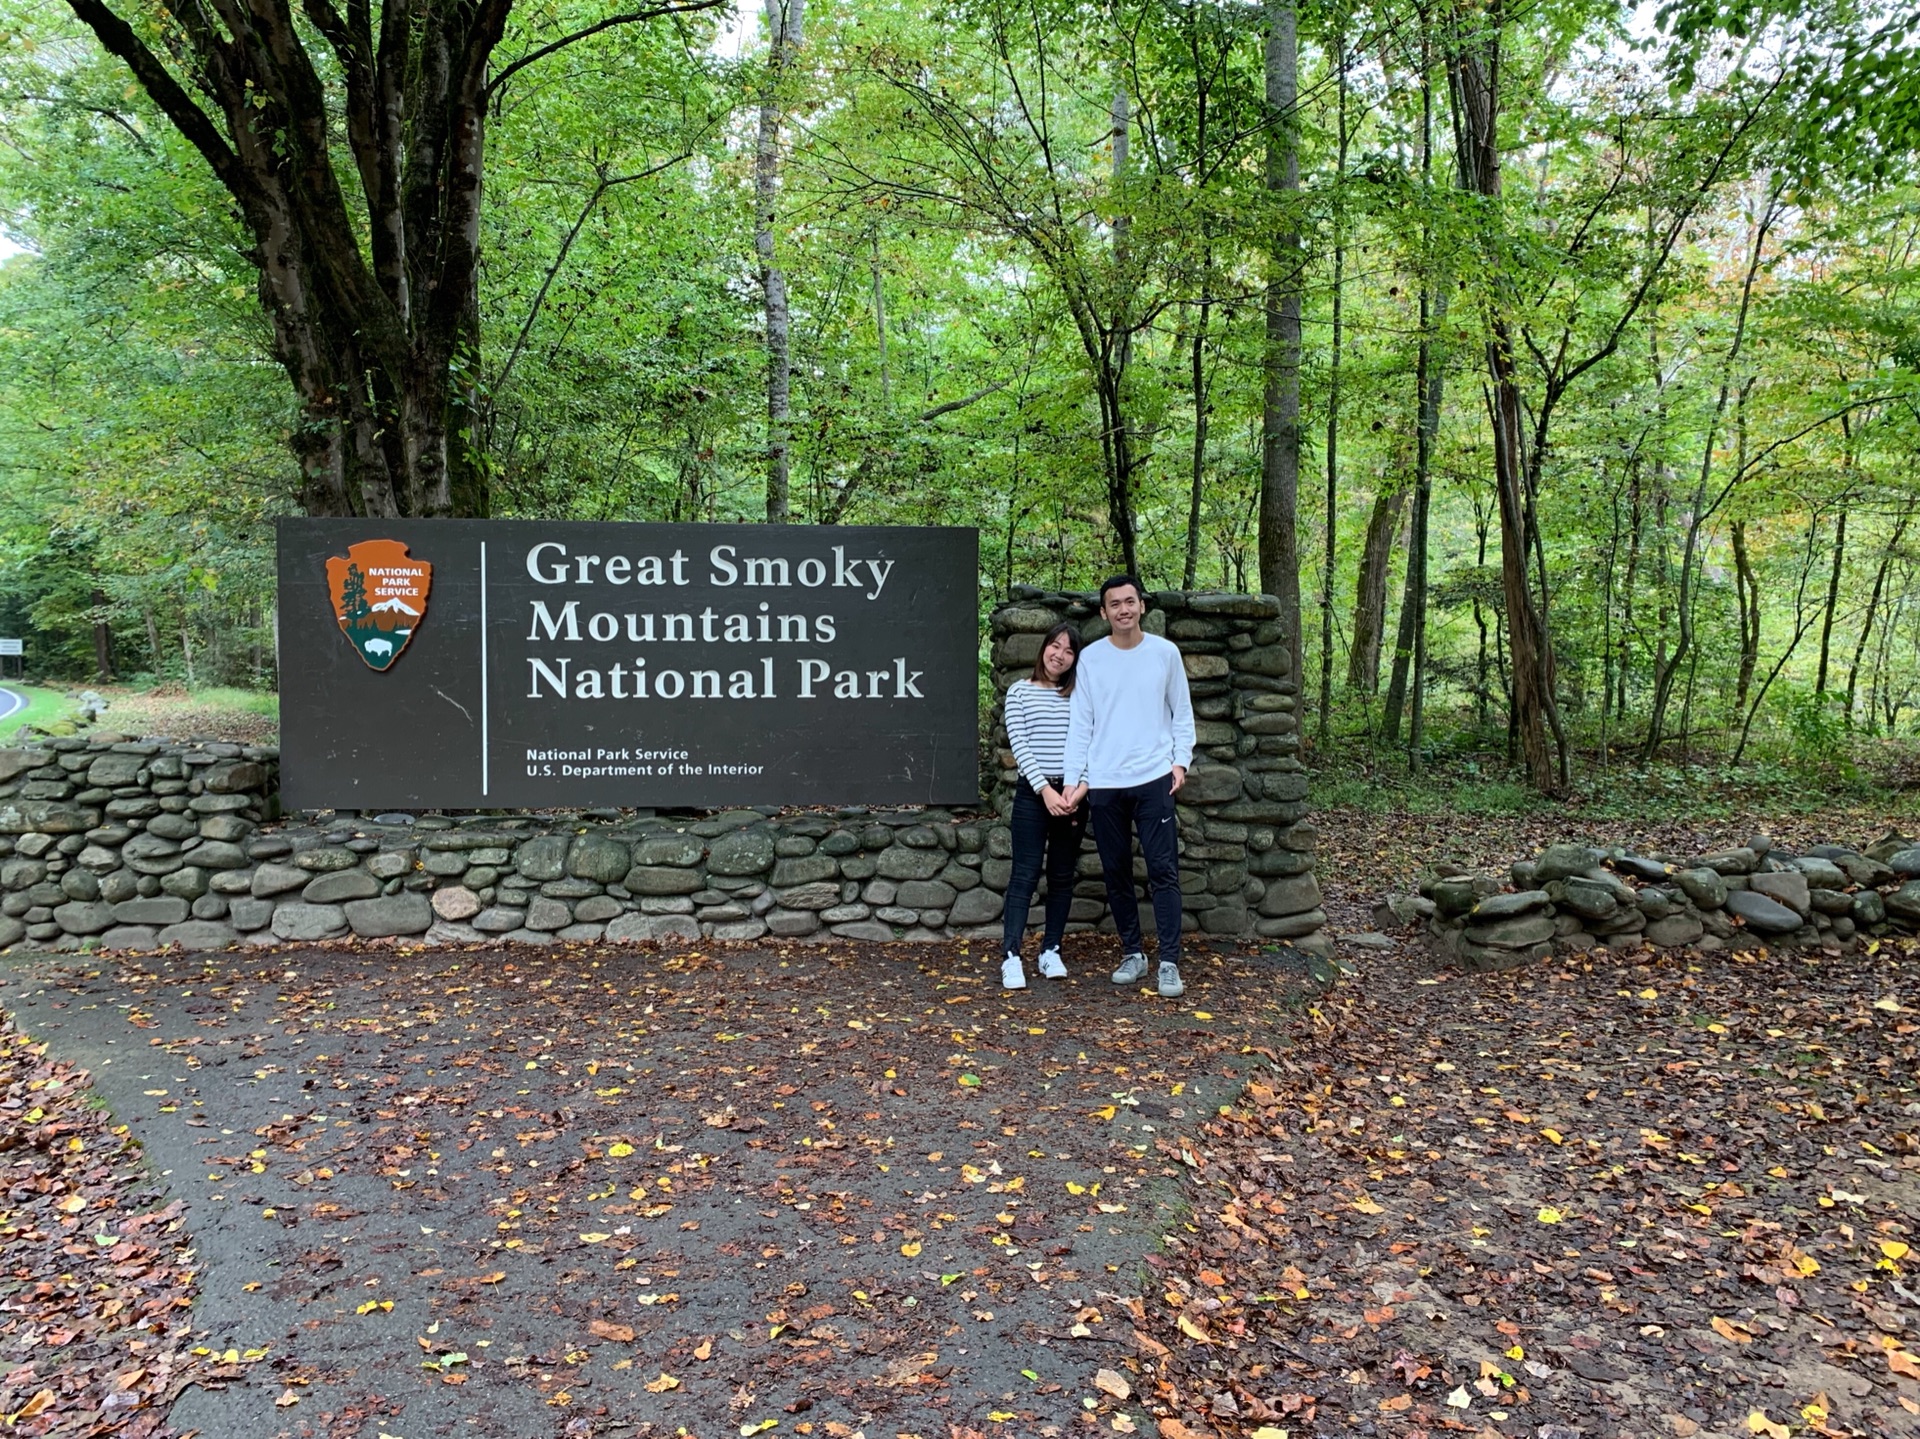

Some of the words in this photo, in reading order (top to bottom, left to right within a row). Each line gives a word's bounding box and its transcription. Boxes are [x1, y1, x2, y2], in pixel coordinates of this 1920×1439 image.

[369, 568, 423, 576] NATIONAL
[527, 542, 689, 585] Great
[710, 545, 894, 600] Smoky
[382, 578, 410, 586] PARK
[375, 587, 418, 596] SERVICE
[527, 601, 836, 642] Mountains
[527, 657, 776, 699] National
[797, 658, 924, 698] Park
[527, 748, 591, 760] National
[597, 748, 629, 760] Park
[636, 748, 688, 760] Service
[527, 764, 556, 776] U.S.
[563, 764, 653, 778] Department
[657, 763, 673, 775] of
[679, 763, 702, 775] the
[709, 763, 763, 774] Interior
